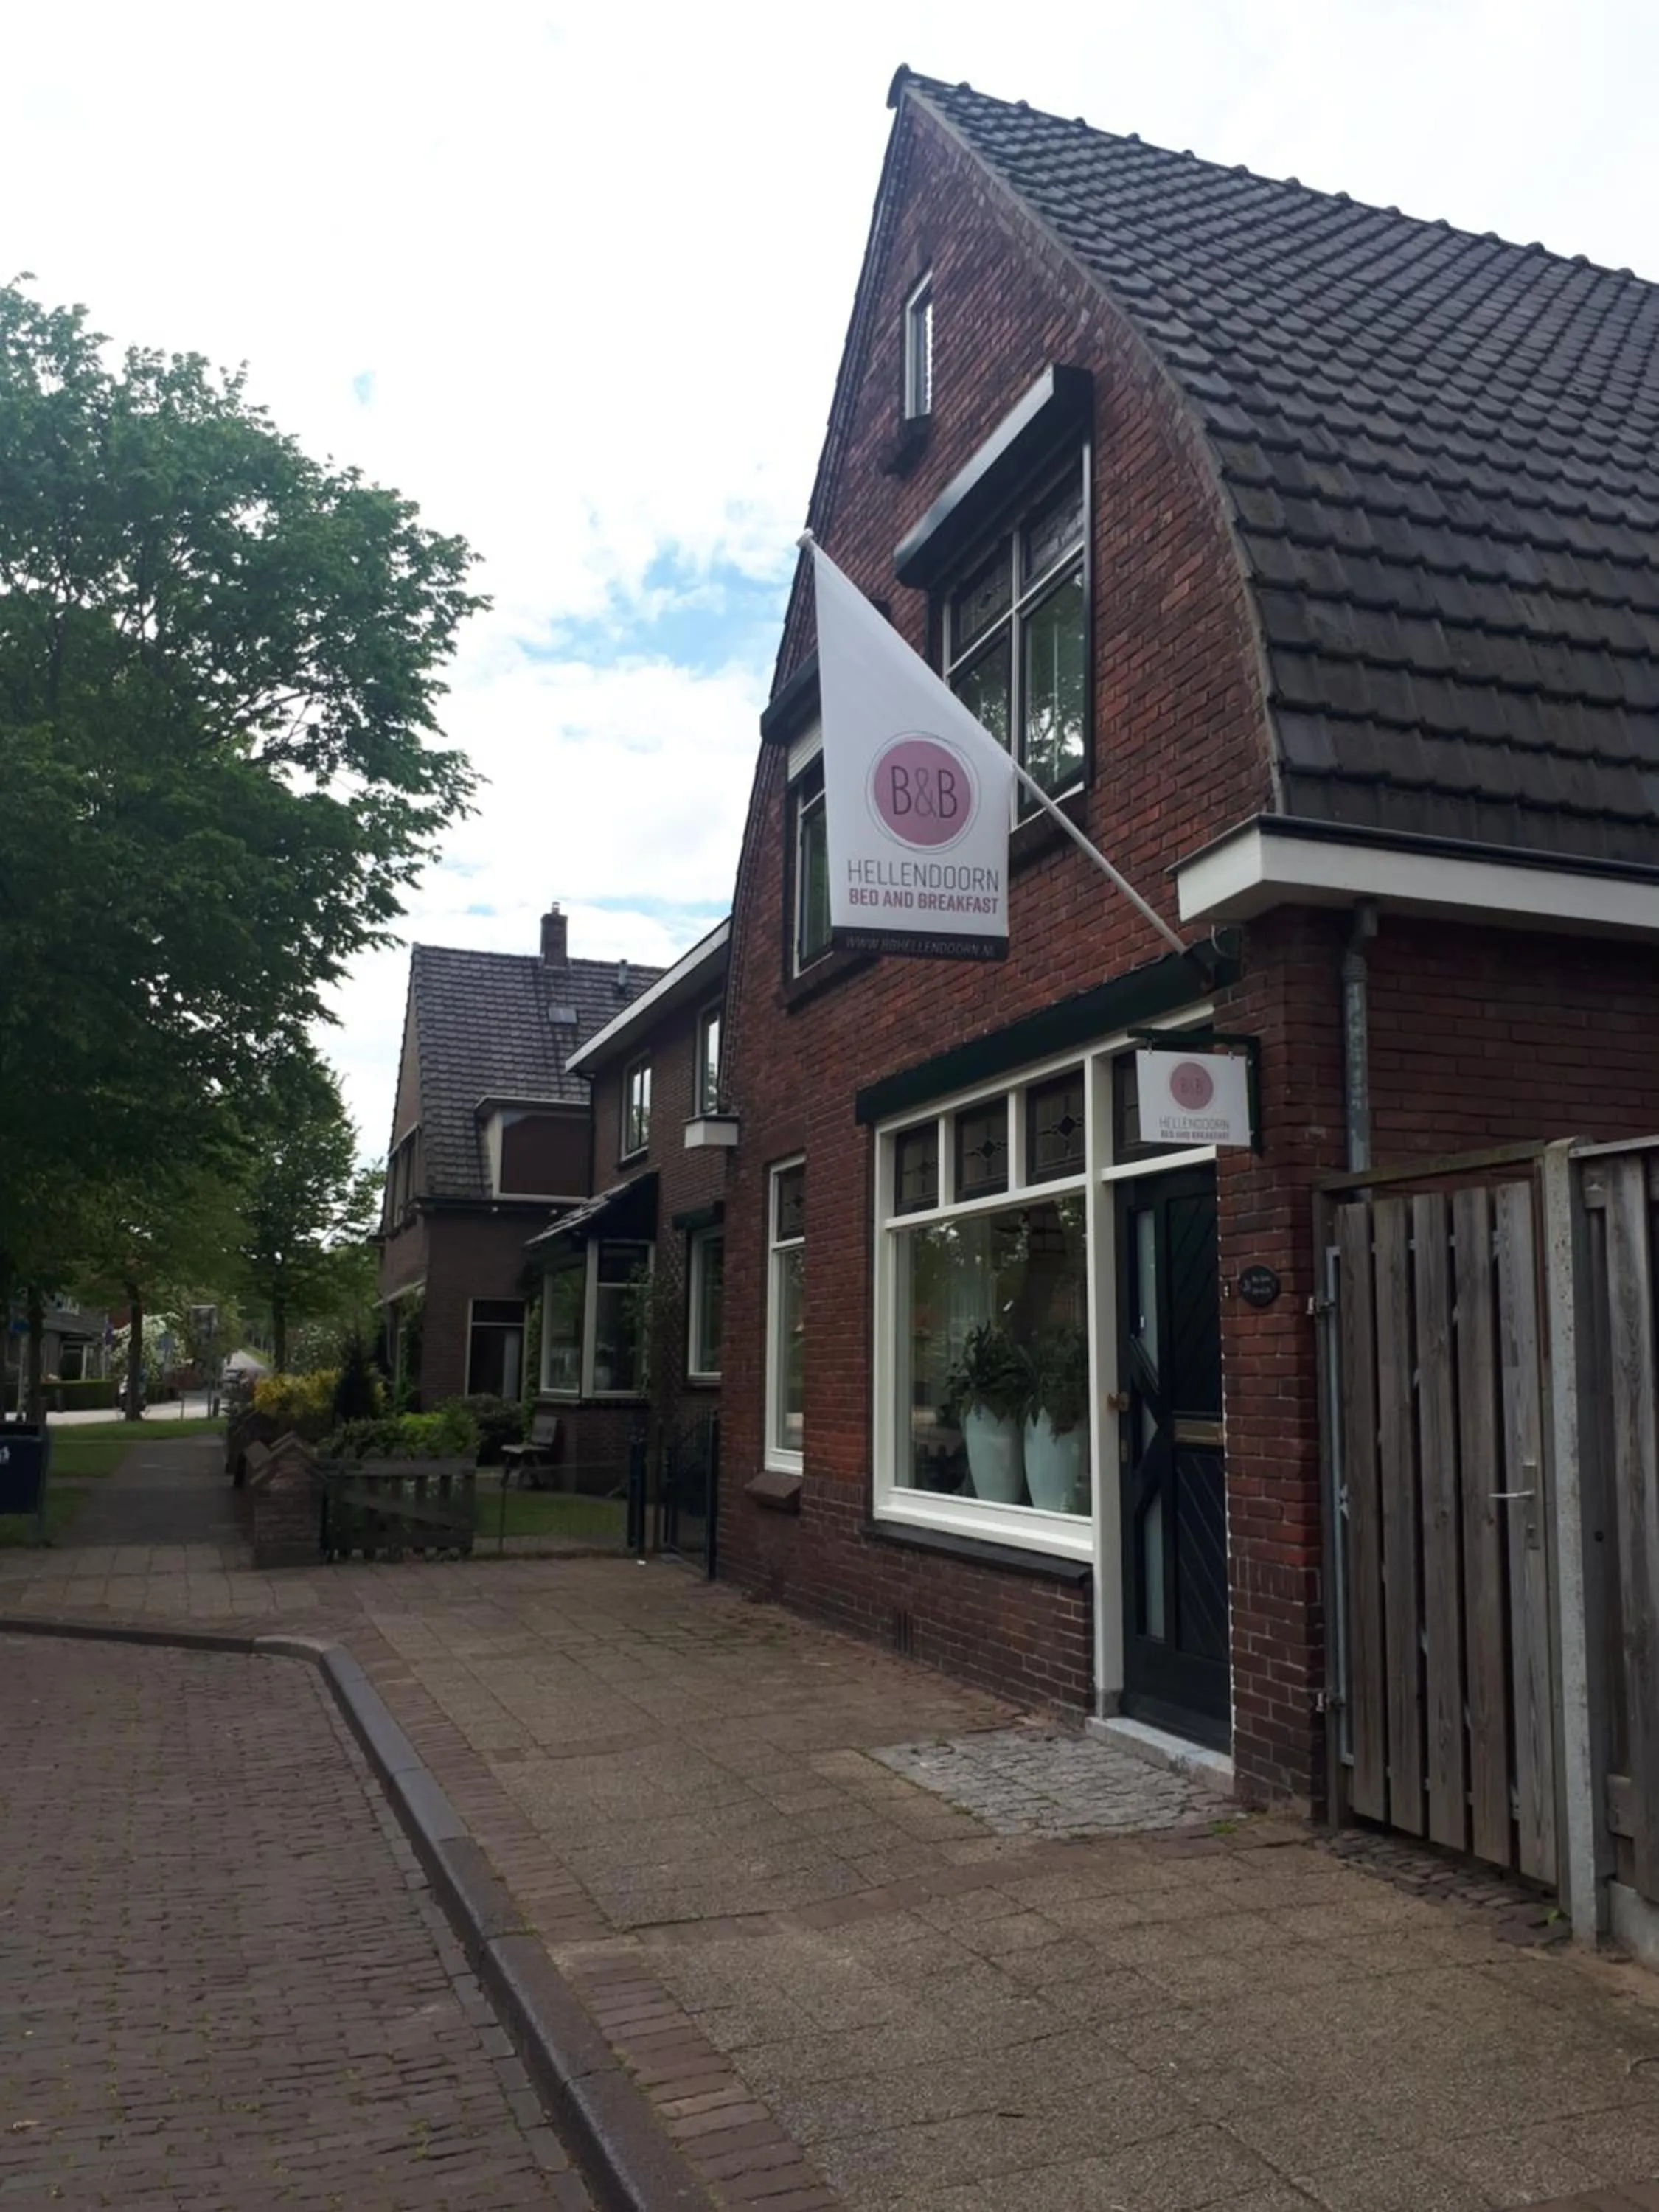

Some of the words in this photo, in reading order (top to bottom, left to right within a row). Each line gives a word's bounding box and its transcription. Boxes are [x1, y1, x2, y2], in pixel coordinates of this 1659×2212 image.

[891, 765, 957, 818] B&B
[847, 859, 999, 891] HELLENDOORN
[849, 888, 878, 905] BED
[883, 890, 914, 909] AND
[917, 892, 999, 914] BREAKFAST
